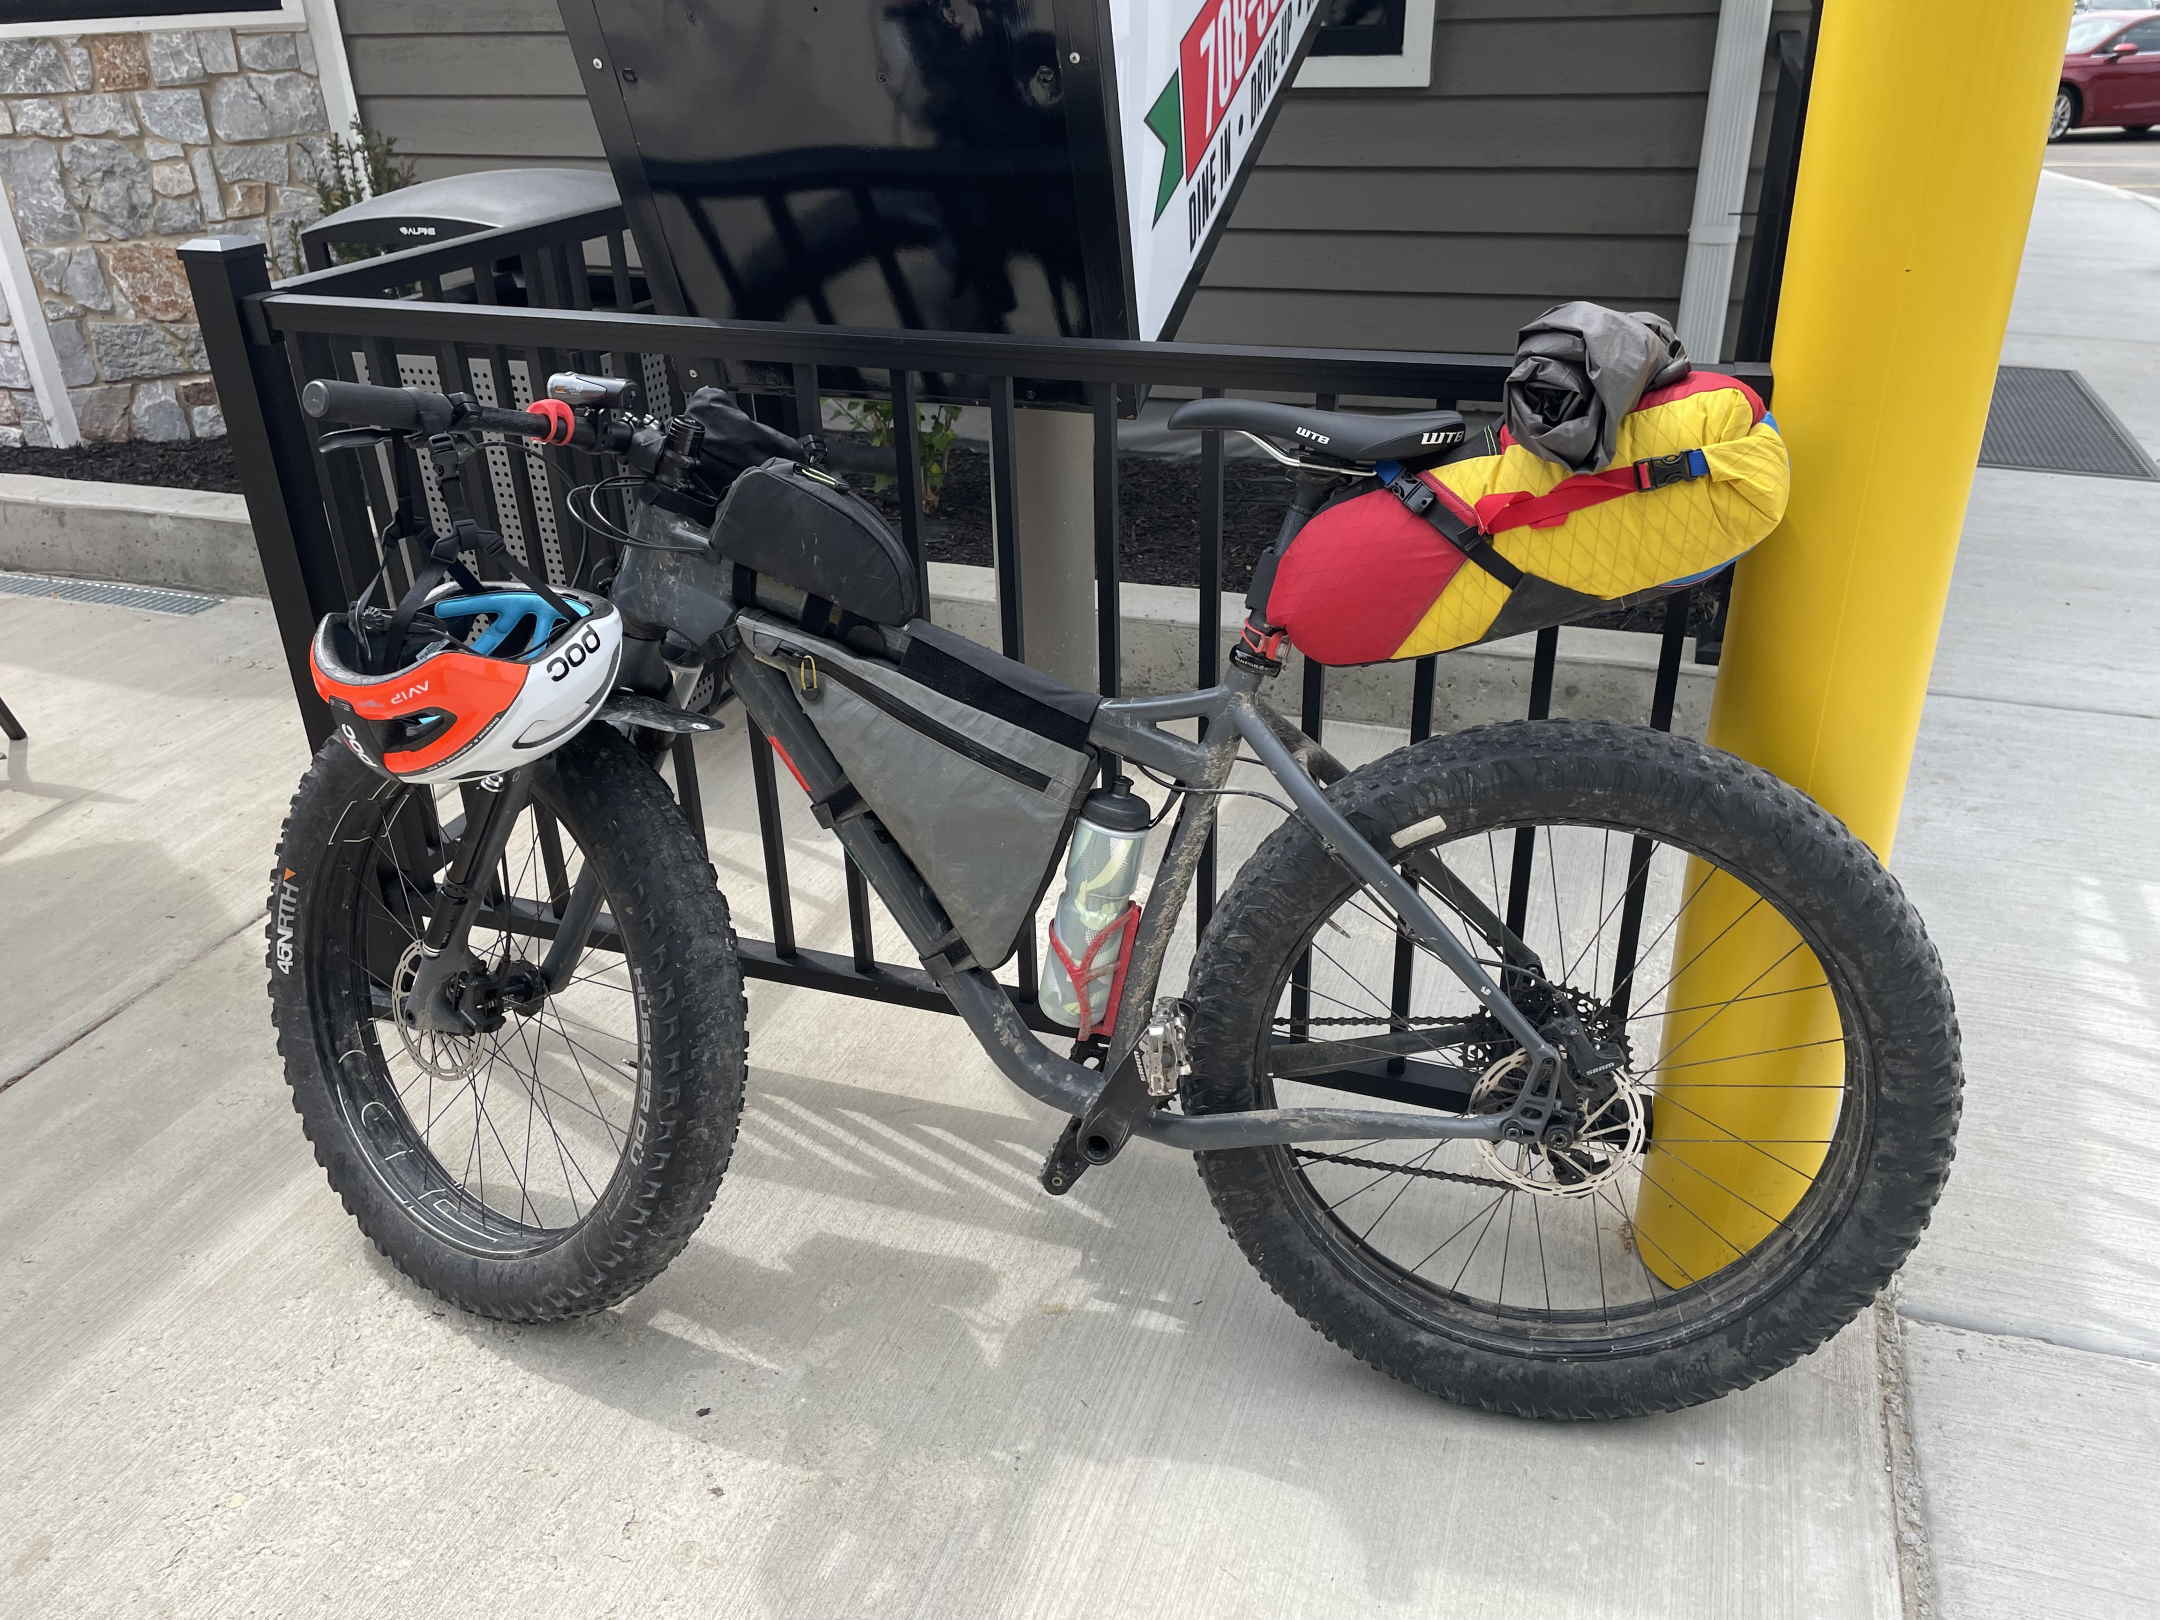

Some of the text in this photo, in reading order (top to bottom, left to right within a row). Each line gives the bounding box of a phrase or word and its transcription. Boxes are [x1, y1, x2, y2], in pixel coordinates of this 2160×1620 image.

[1189, 0, 1293, 254] DINE IN DRIVE UP
[1295, 426, 1330, 445] WTB
[1421, 431, 1465, 445] WTB
[546, 624, 602, 682] POC
[391, 679, 429, 705] AVIP
[276, 880, 300, 975] 45NRTH
[630, 1120, 648, 1168] DÜ
